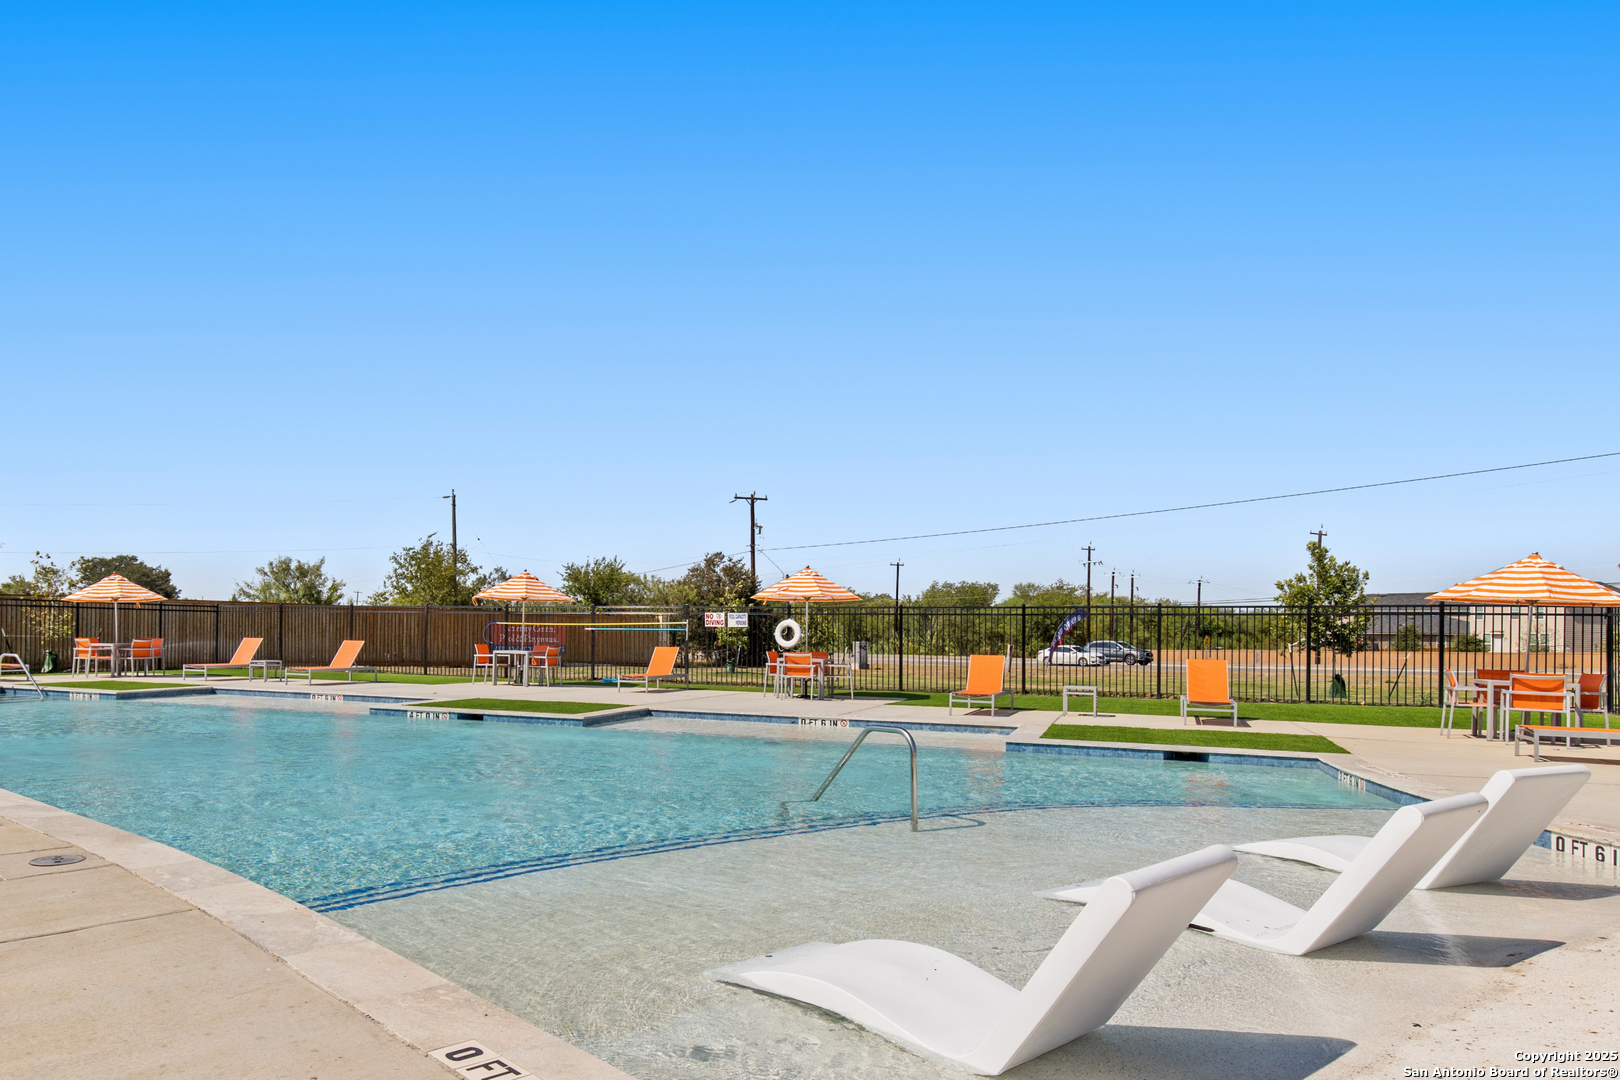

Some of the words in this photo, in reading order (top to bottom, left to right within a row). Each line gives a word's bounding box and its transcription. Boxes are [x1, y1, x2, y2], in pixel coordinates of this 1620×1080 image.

[1556, 836, 1565, 852] 0
[1572, 839, 1588, 858] FT
[1595, 845, 1605, 862] 6
[1613, 849, 1620, 866] I
[445, 1046, 484, 1061] 0
[466, 1060, 522, 1080] FT
